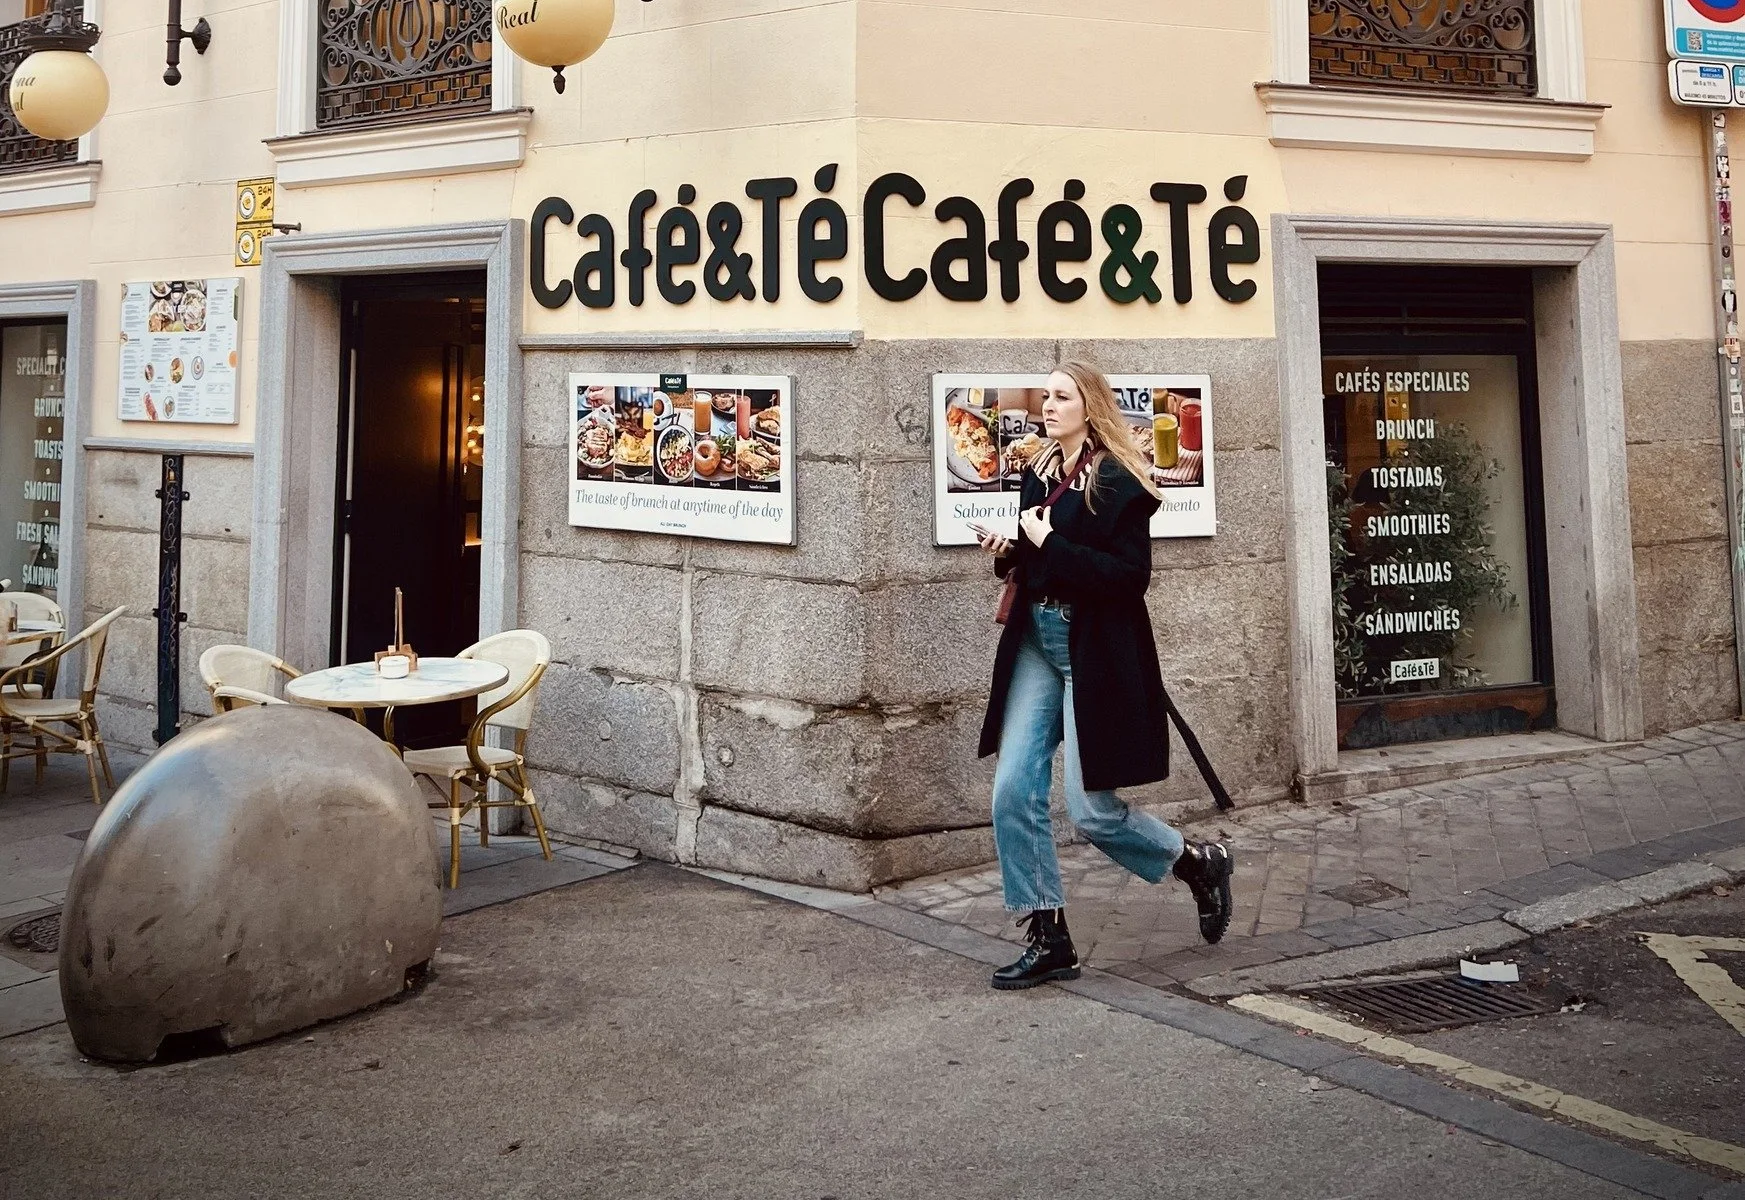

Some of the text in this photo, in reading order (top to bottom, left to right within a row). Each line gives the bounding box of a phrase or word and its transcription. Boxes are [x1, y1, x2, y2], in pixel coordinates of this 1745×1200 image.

[497, 0, 540, 29] Real
[258, 186, 273, 196] 24H
[530, 163, 848, 309] Café&Té
[862, 172, 1261, 304] Café&Té
[1335, 366, 1470, 393] CAFÉS ESPECIALES
[1376, 418, 1435, 440] BRUNCH
[34, 440, 63, 459] TOASTS
[1371, 466, 1442, 488] TOSTADAS
[576, 490, 783, 522] The taste of brunch at anytime of the day
[953, 503, 994, 518] Sabor
[997, 506, 1005, 517] a
[16, 521, 42, 542] FRESH
[1368, 514, 1450, 537] SMOOTHIES
[1370, 562, 1452, 586] ENSALADAS
[1365, 608, 1460, 636] SÁNDWICHES
[1394, 661, 1435, 678] Café&Té
